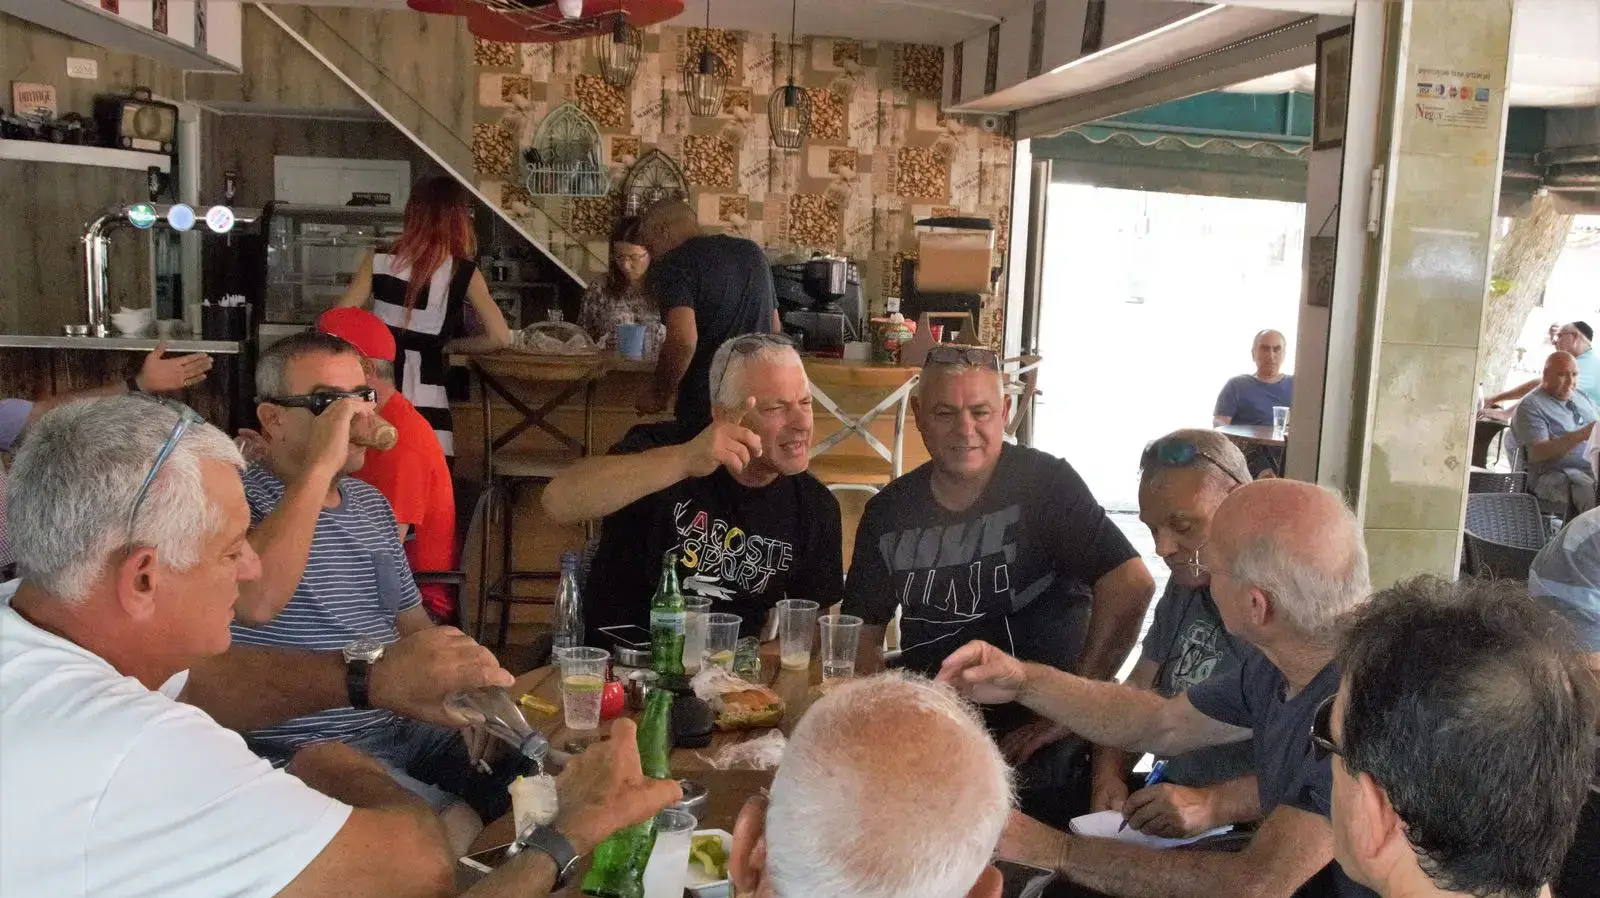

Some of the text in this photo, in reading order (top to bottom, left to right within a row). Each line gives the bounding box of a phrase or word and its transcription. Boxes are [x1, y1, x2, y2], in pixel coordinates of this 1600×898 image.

[19, 90, 52, 103] VINTAGE
[674, 499, 793, 571] LACOSTE
[680, 538, 776, 594] SPORT
